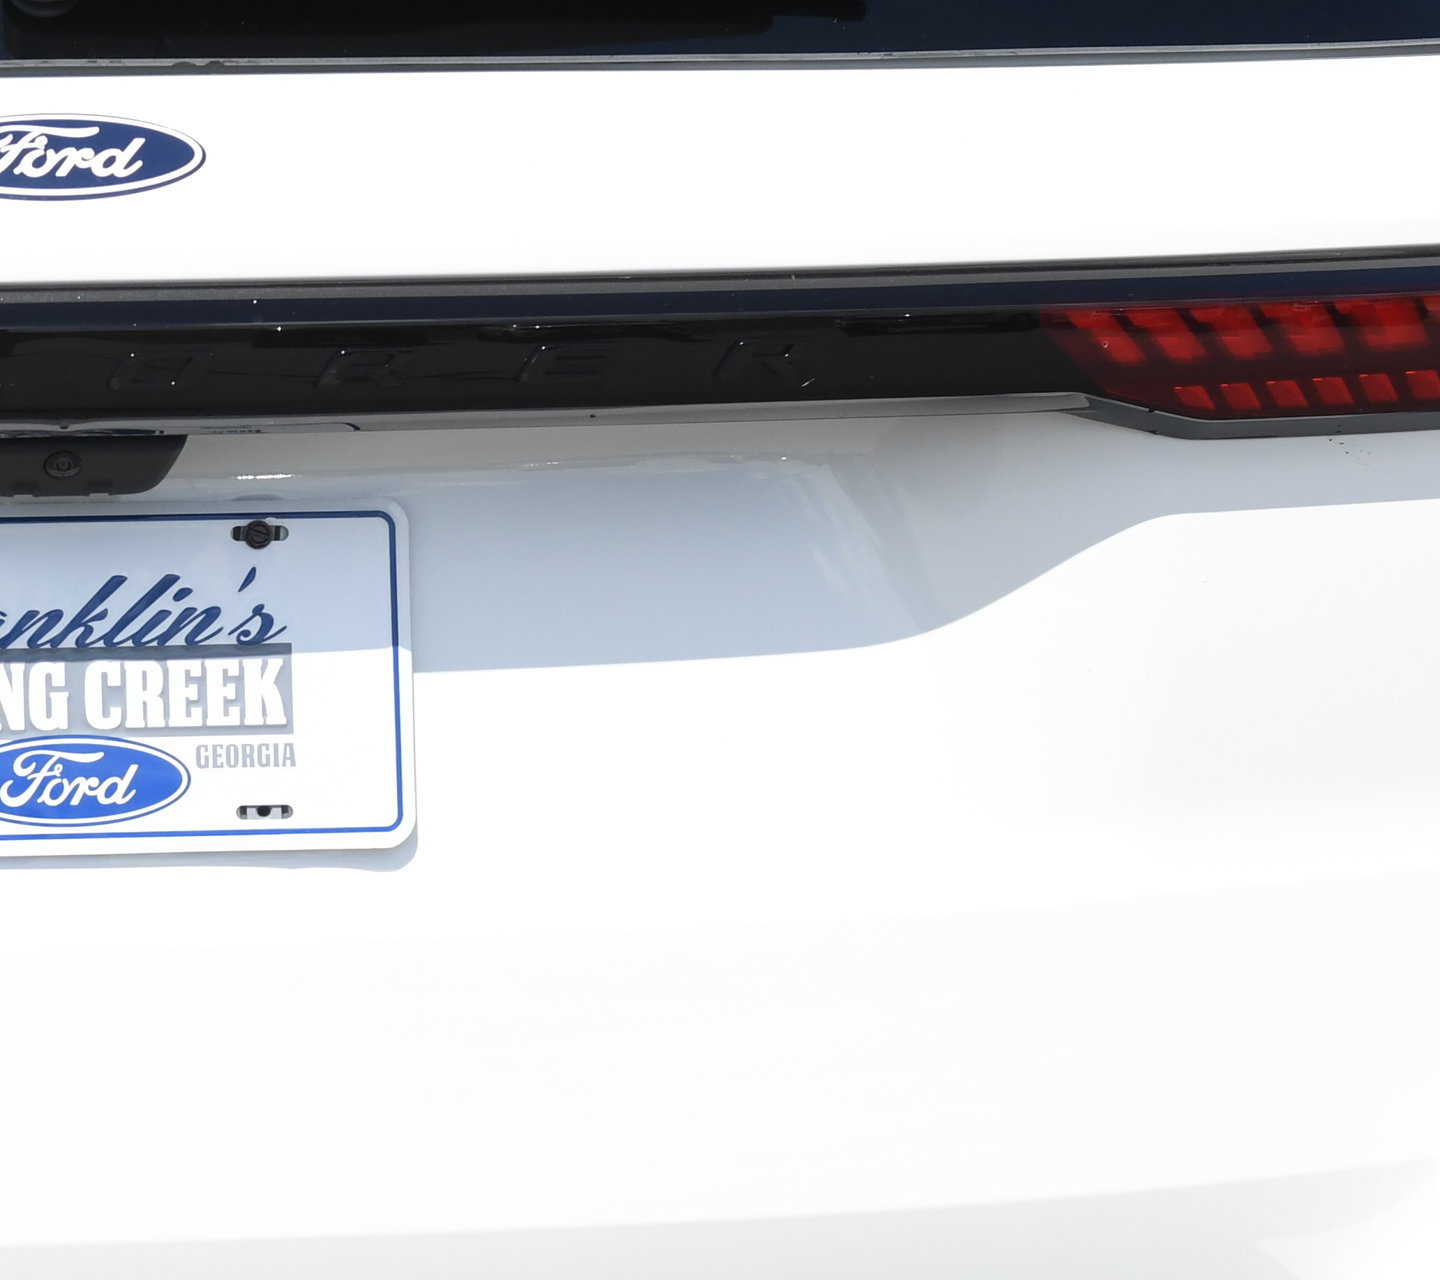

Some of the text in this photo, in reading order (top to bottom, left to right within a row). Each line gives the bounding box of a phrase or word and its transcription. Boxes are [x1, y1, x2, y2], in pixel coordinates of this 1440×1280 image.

[83, 657, 288, 731] CREEK
[0, 749, 138, 808] Ford
[195, 743, 298, 770] GEORGIA
